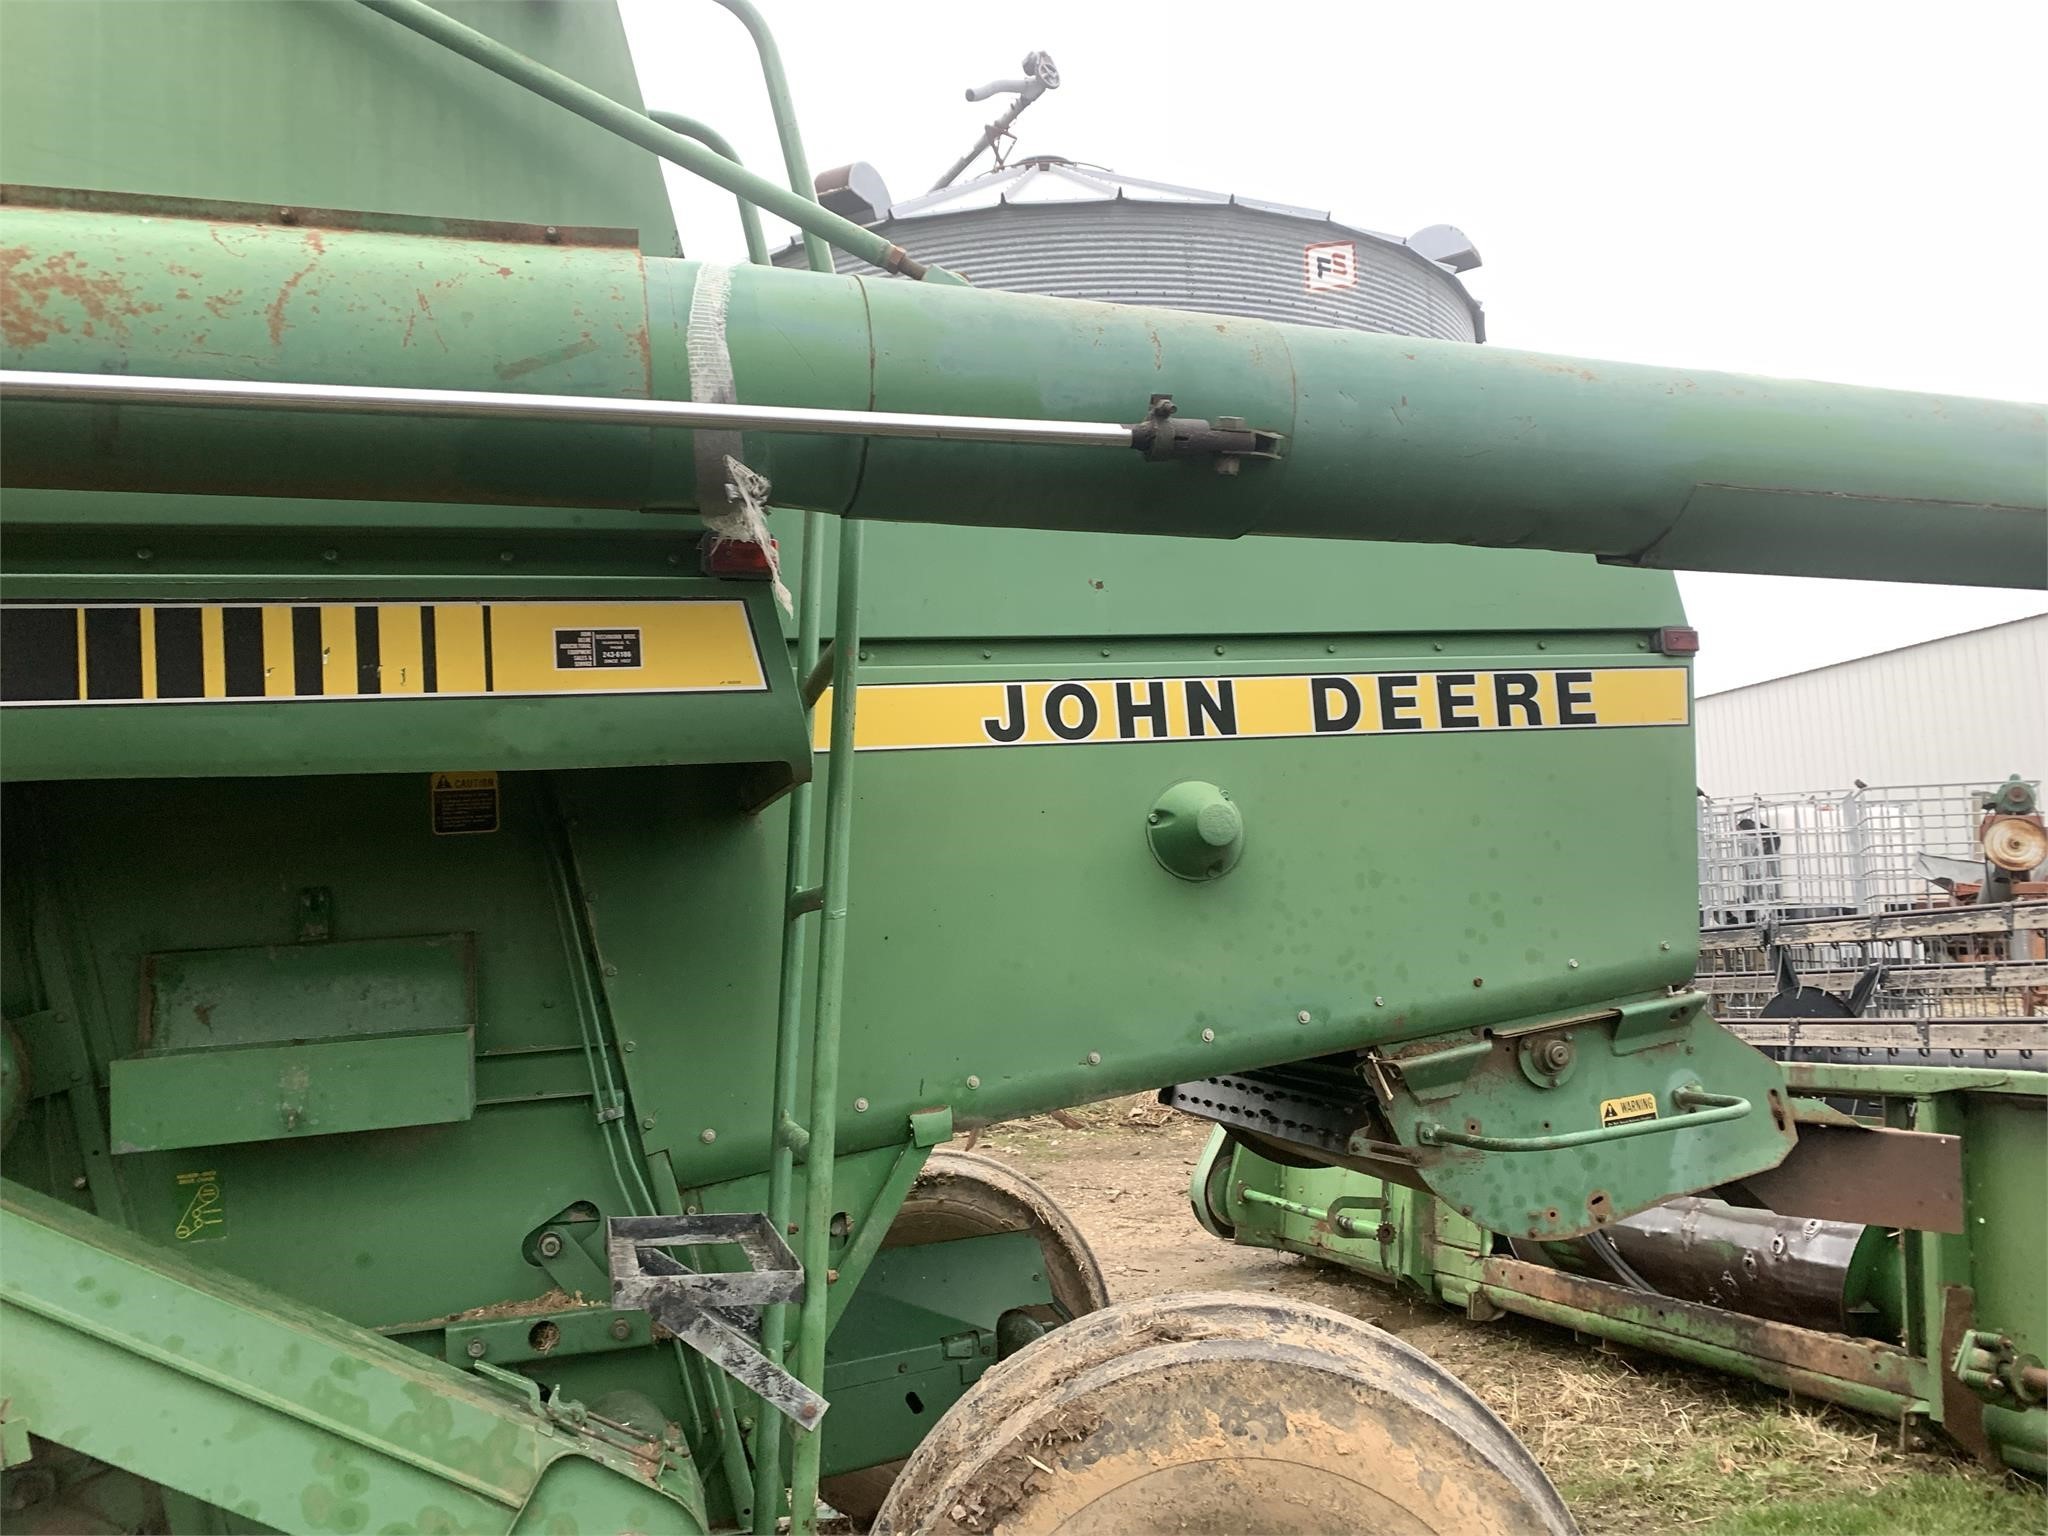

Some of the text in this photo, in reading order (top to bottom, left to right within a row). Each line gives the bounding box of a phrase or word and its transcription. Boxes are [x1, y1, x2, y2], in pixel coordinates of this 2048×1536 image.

[1317, 253, 1348, 279] FS
[984, 671, 1597, 744] JOHN DEERE
[454, 778, 494, 788] CAUTION
[1620, 1097, 1653, 1113] WARNING
